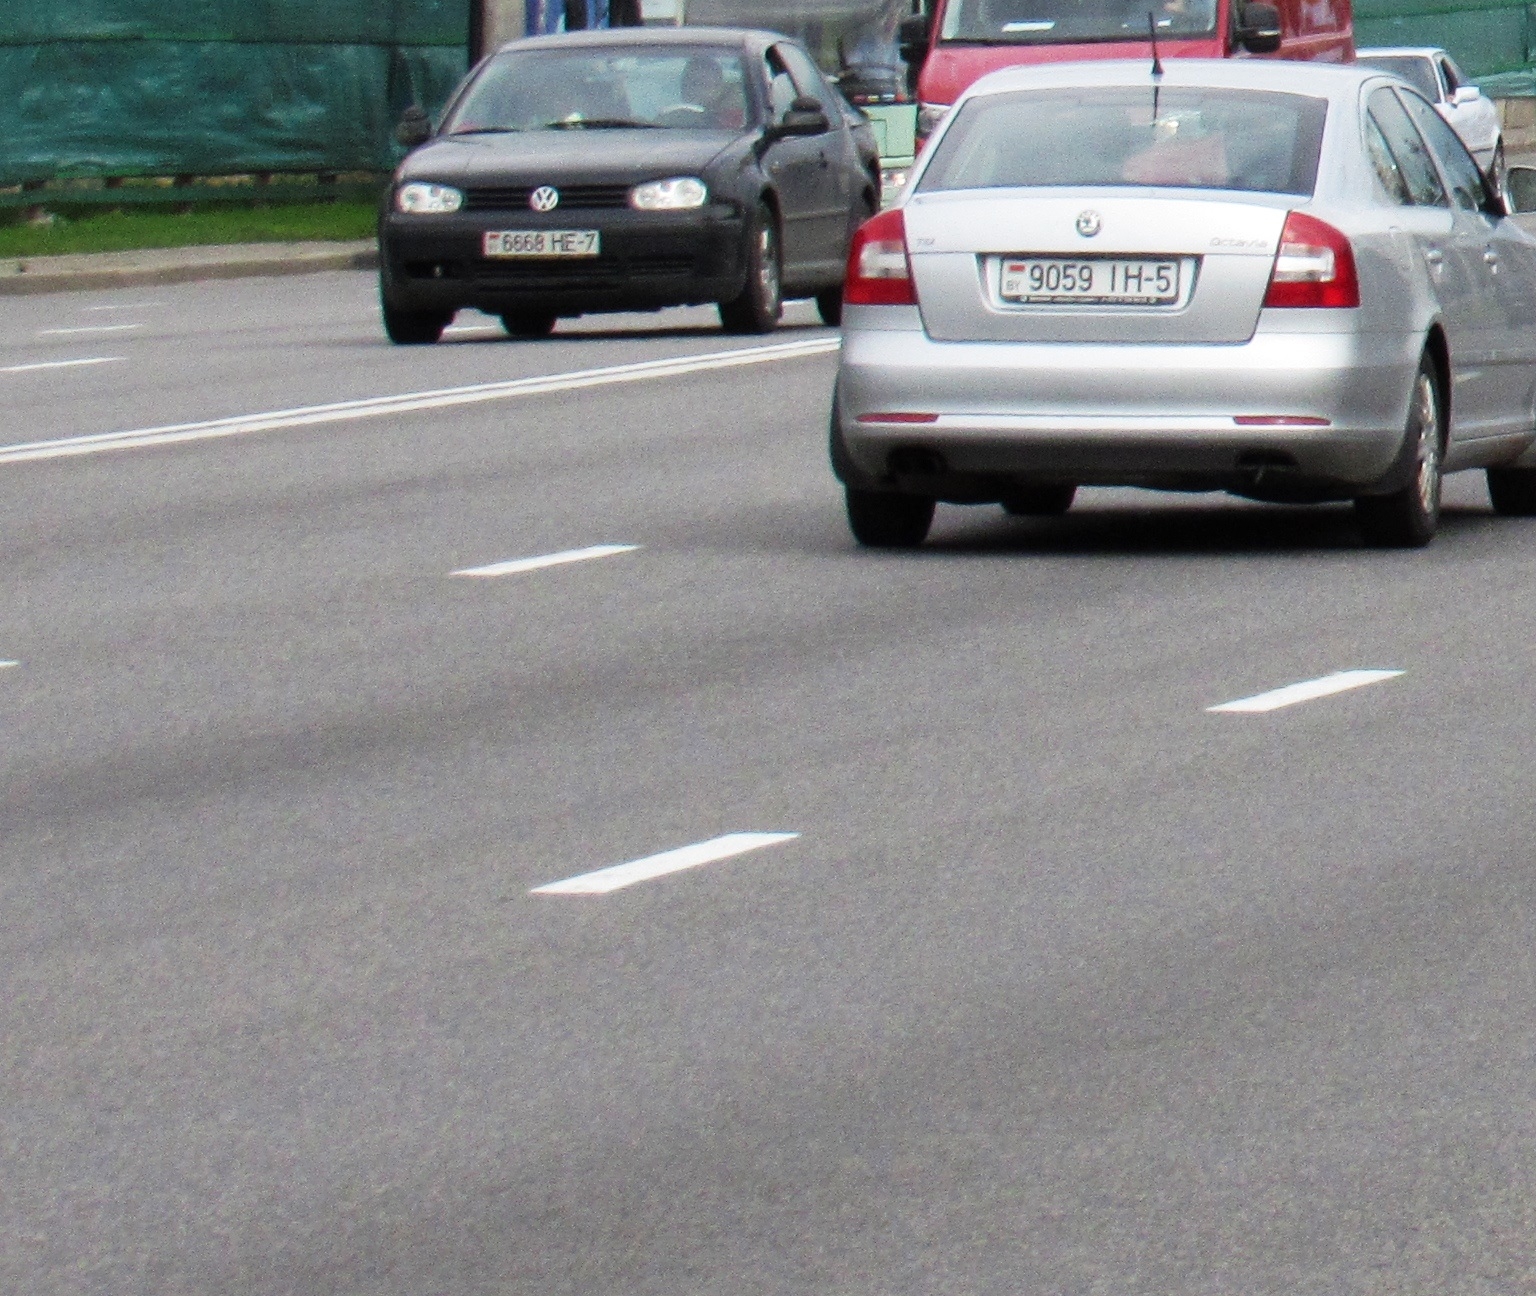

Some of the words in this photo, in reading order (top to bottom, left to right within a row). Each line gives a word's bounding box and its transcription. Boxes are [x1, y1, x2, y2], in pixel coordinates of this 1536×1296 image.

[1208, 236, 1269, 249] Octavia
[1029, 264, 1094, 292] 9059
[1109, 264, 1172, 294] IH-5
